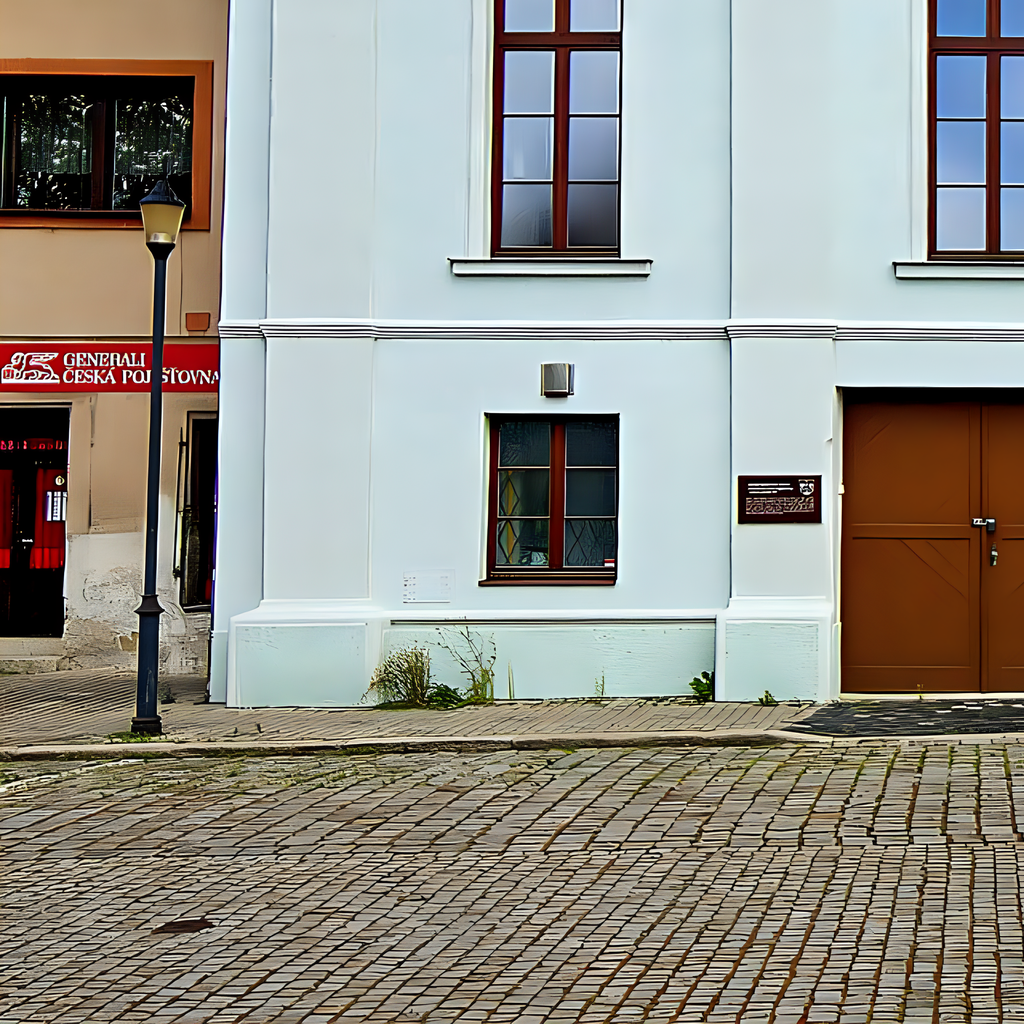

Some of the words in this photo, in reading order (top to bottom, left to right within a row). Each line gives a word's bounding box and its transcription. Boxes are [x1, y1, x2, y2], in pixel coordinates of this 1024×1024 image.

[63, 352, 146, 367] GENERALI
[62, 366, 117, 384] ČESKÁ
[122, 367, 219, 385] POJŠŤOVNA
